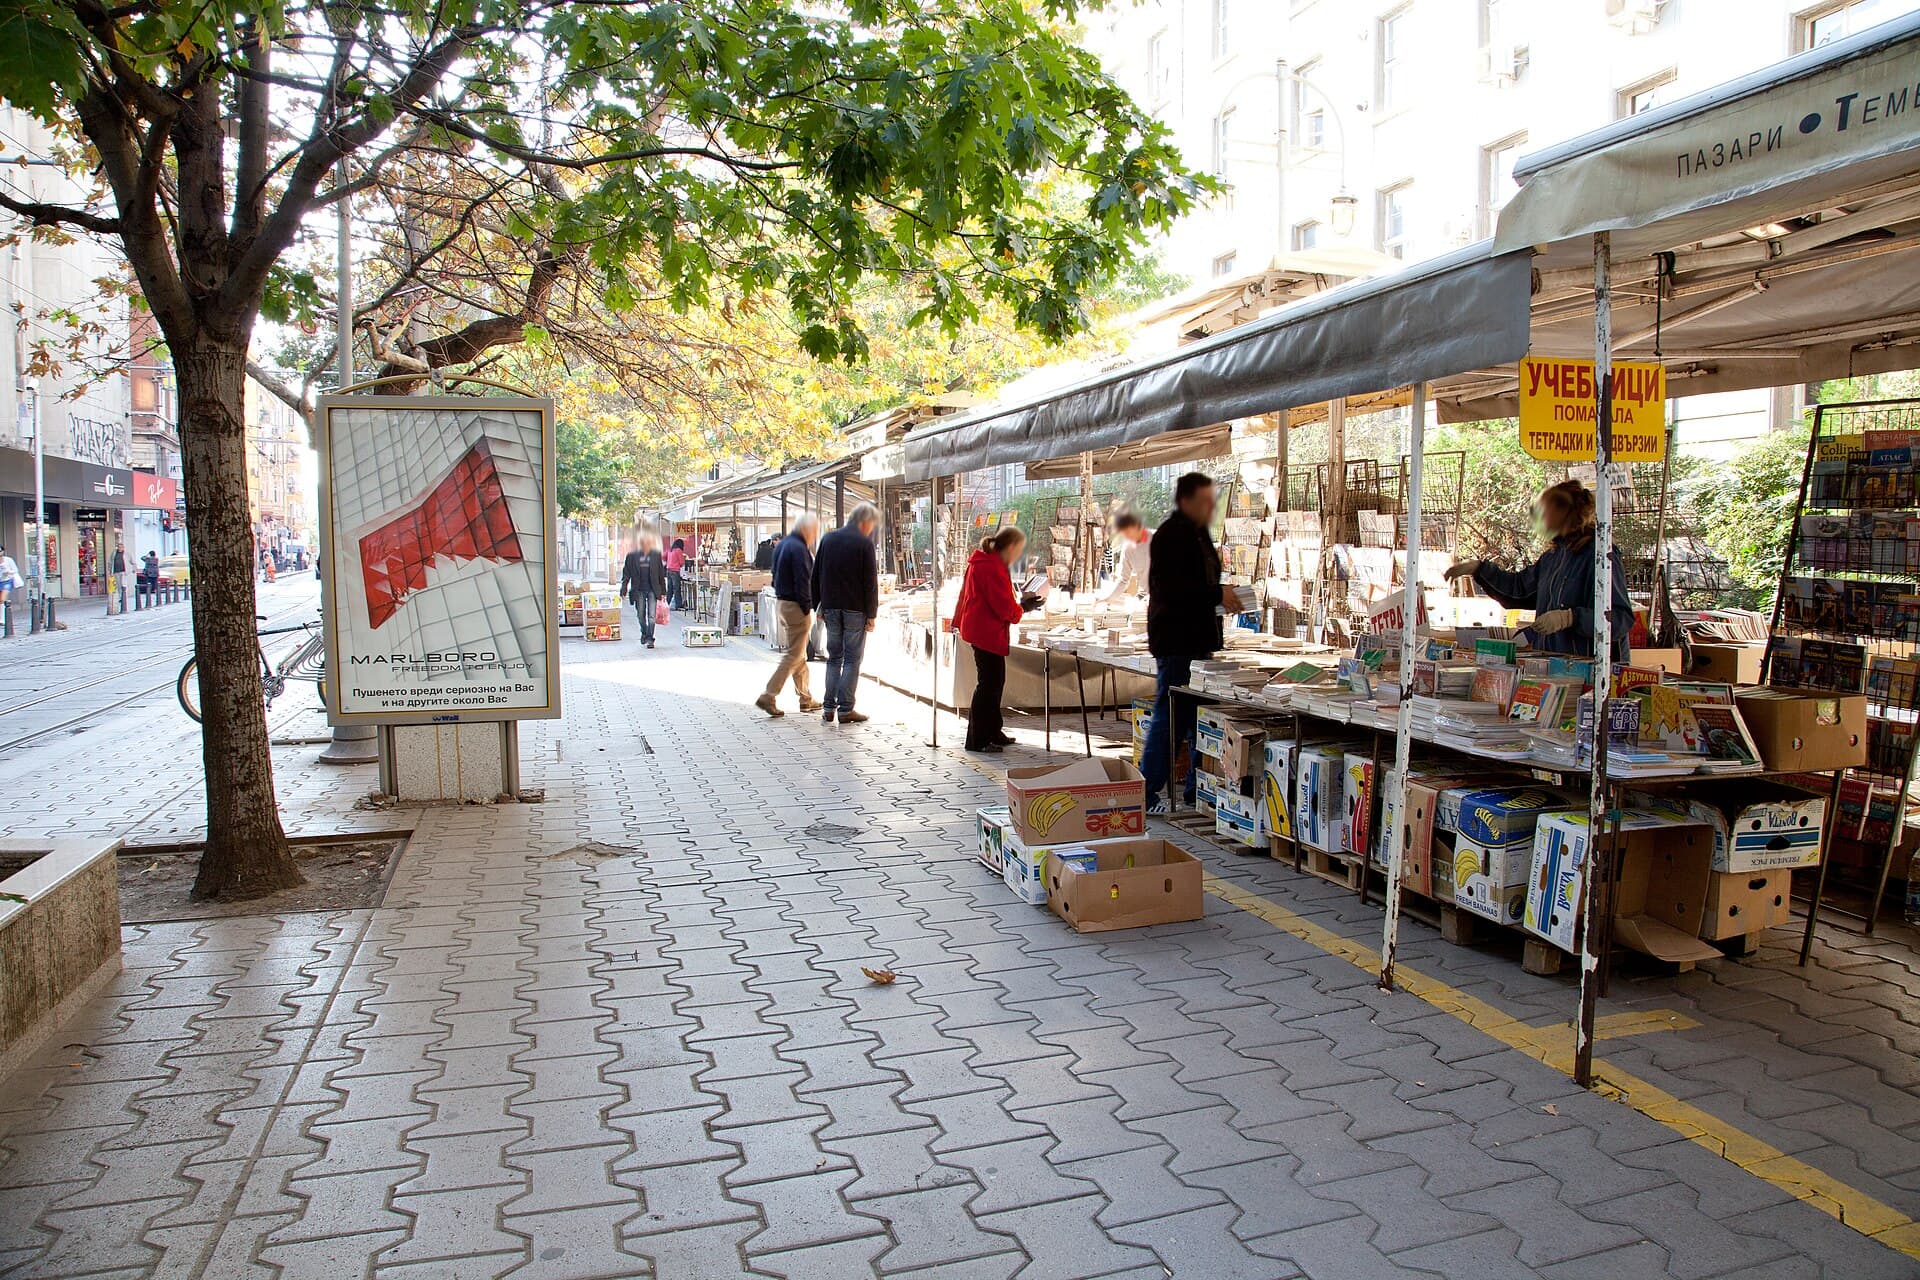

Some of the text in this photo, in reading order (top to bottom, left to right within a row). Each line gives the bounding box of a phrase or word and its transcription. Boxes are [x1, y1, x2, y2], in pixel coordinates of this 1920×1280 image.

[1677, 125, 1783, 178] ПАЗАРИ
[1528, 362, 1660, 409] УЧЕБИЦИ
[1554, 404, 1634, 424] ПОМАЛА
[1528, 431, 1658, 455] ТЕТРАДКИ И ДВЪРЗИИ
[1820, 443, 1860, 456] Collins
[351, 652, 496, 665] MARLBORO
[391, 664, 462, 673] FREEDOM
[488, 663, 534, 671] ENJOY
[352, 683, 535, 698] Пушенето вреди сериозно на Вас
[391, 699, 404, 707] на
[407, 698, 450, 708] другите
[452, 696, 485, 705] около
[487, 695, 508, 704] Вас
[1612, 711, 1639, 730] GPS
[1086, 811, 1142, 837] Dole
[1767, 811, 1798, 828] BONITA
[1557, 871, 1576, 911] BONITA
[1455, 894, 1473, 907] FRESH
[1472, 901, 1498, 917] BANANAS
